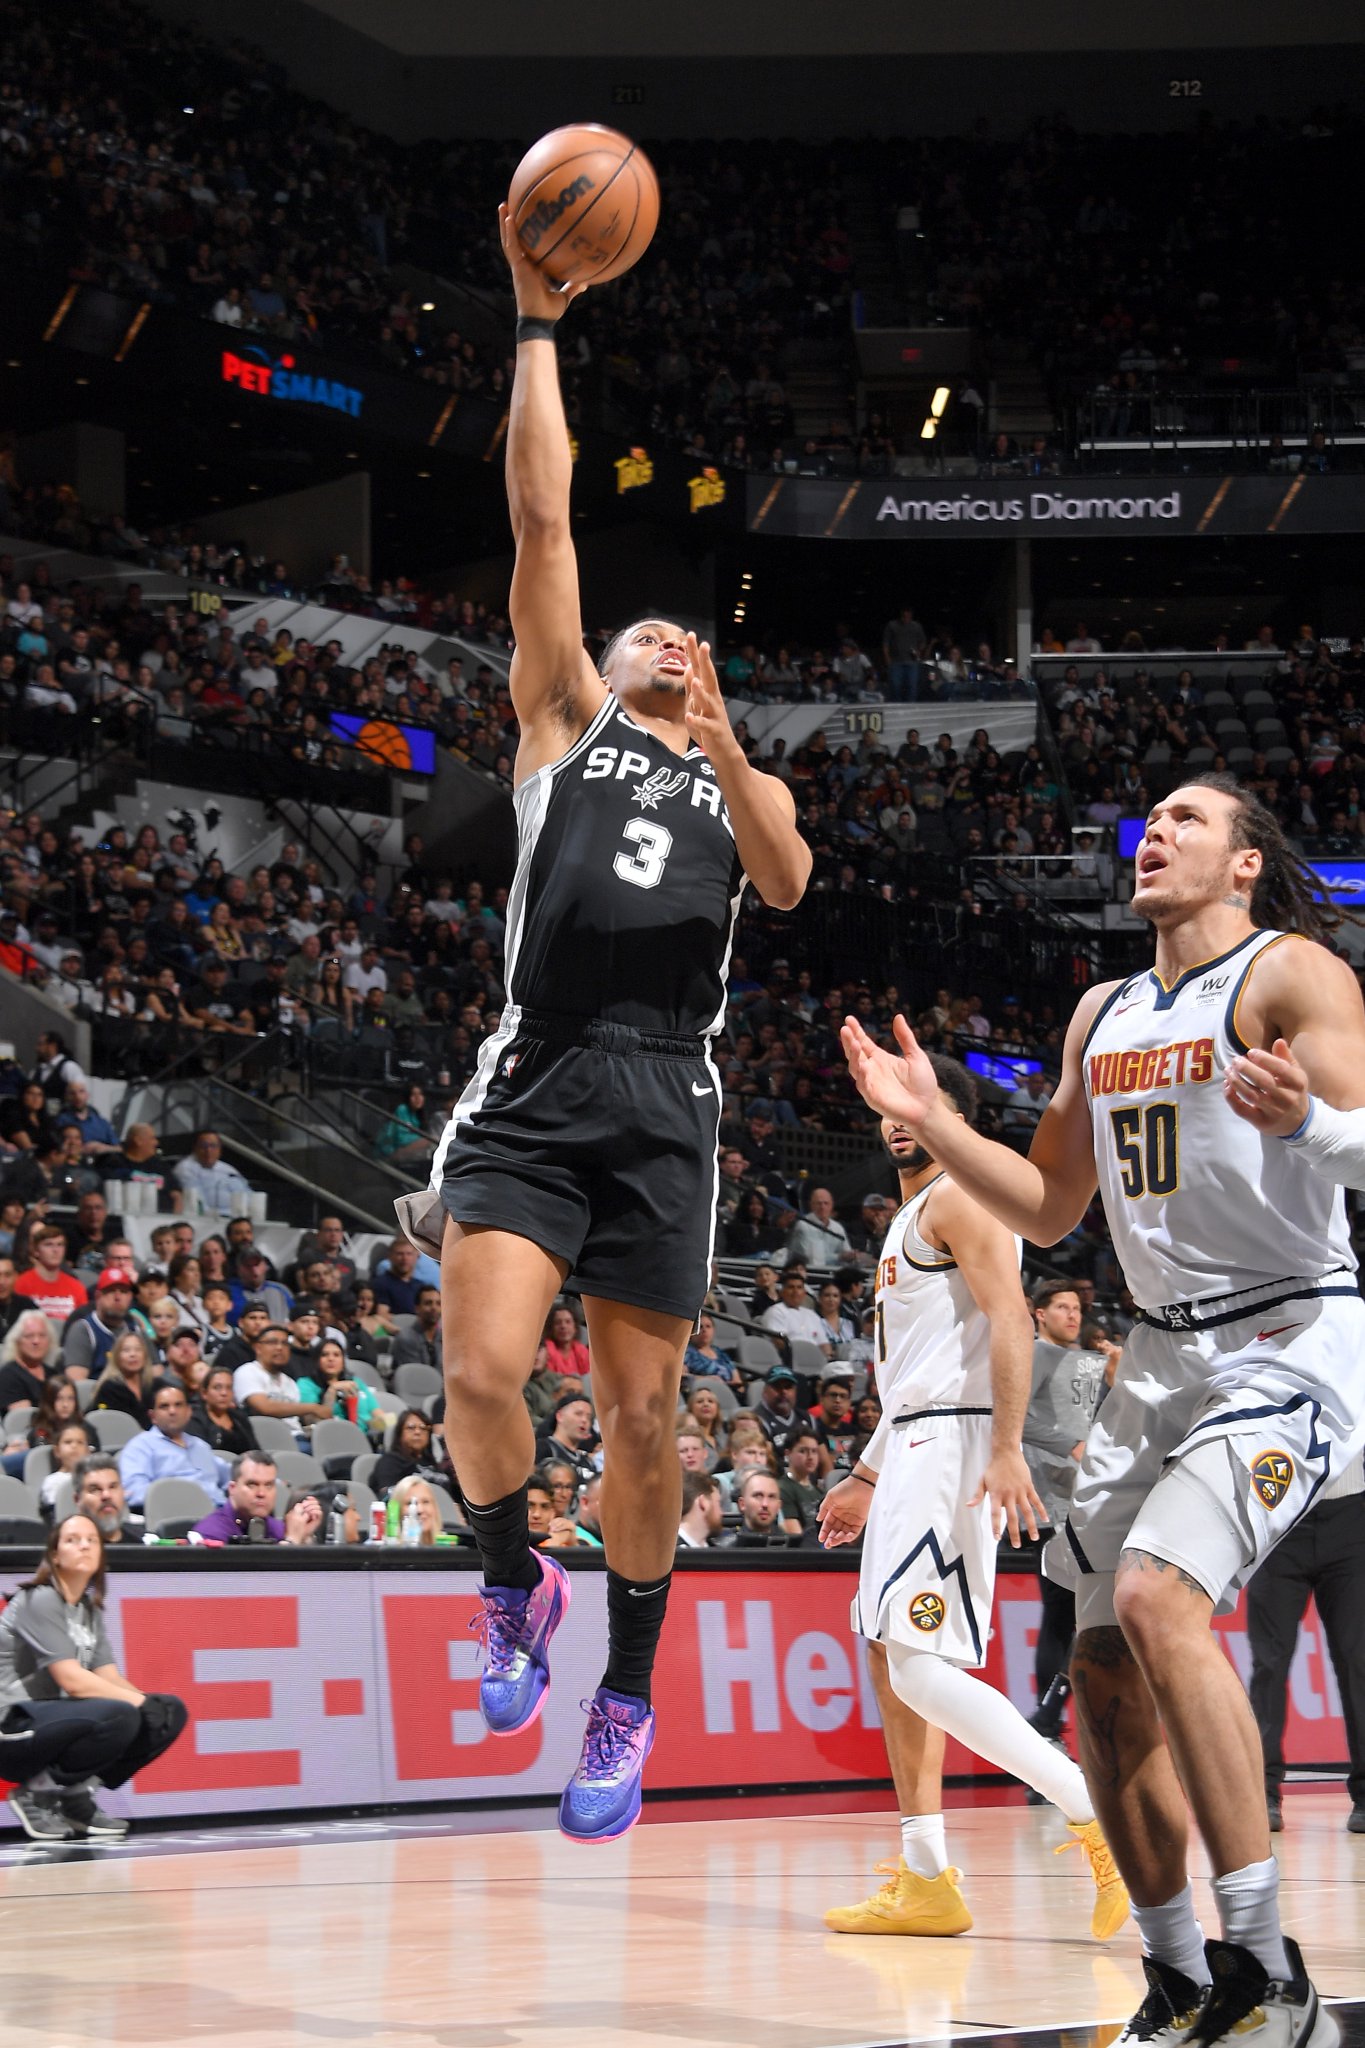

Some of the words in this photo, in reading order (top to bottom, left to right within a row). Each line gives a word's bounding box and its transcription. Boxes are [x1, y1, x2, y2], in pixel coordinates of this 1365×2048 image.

[1169, 80, 1202, 97] 212
[519, 173, 596, 250] Wilson
[221, 351, 366, 418] PETSMART
[875, 493, 1024, 522] Americus
[1029, 491, 1181, 520] Diamond
[189, 591, 222, 616] 109
[845, 712, 883, 733] 110
[612, 816, 674, 890] 3
[1201, 975, 1230, 992] WU
[1089, 1037, 1215, 1099] NUGGETS
[1109, 1100, 1180, 1201] 50
